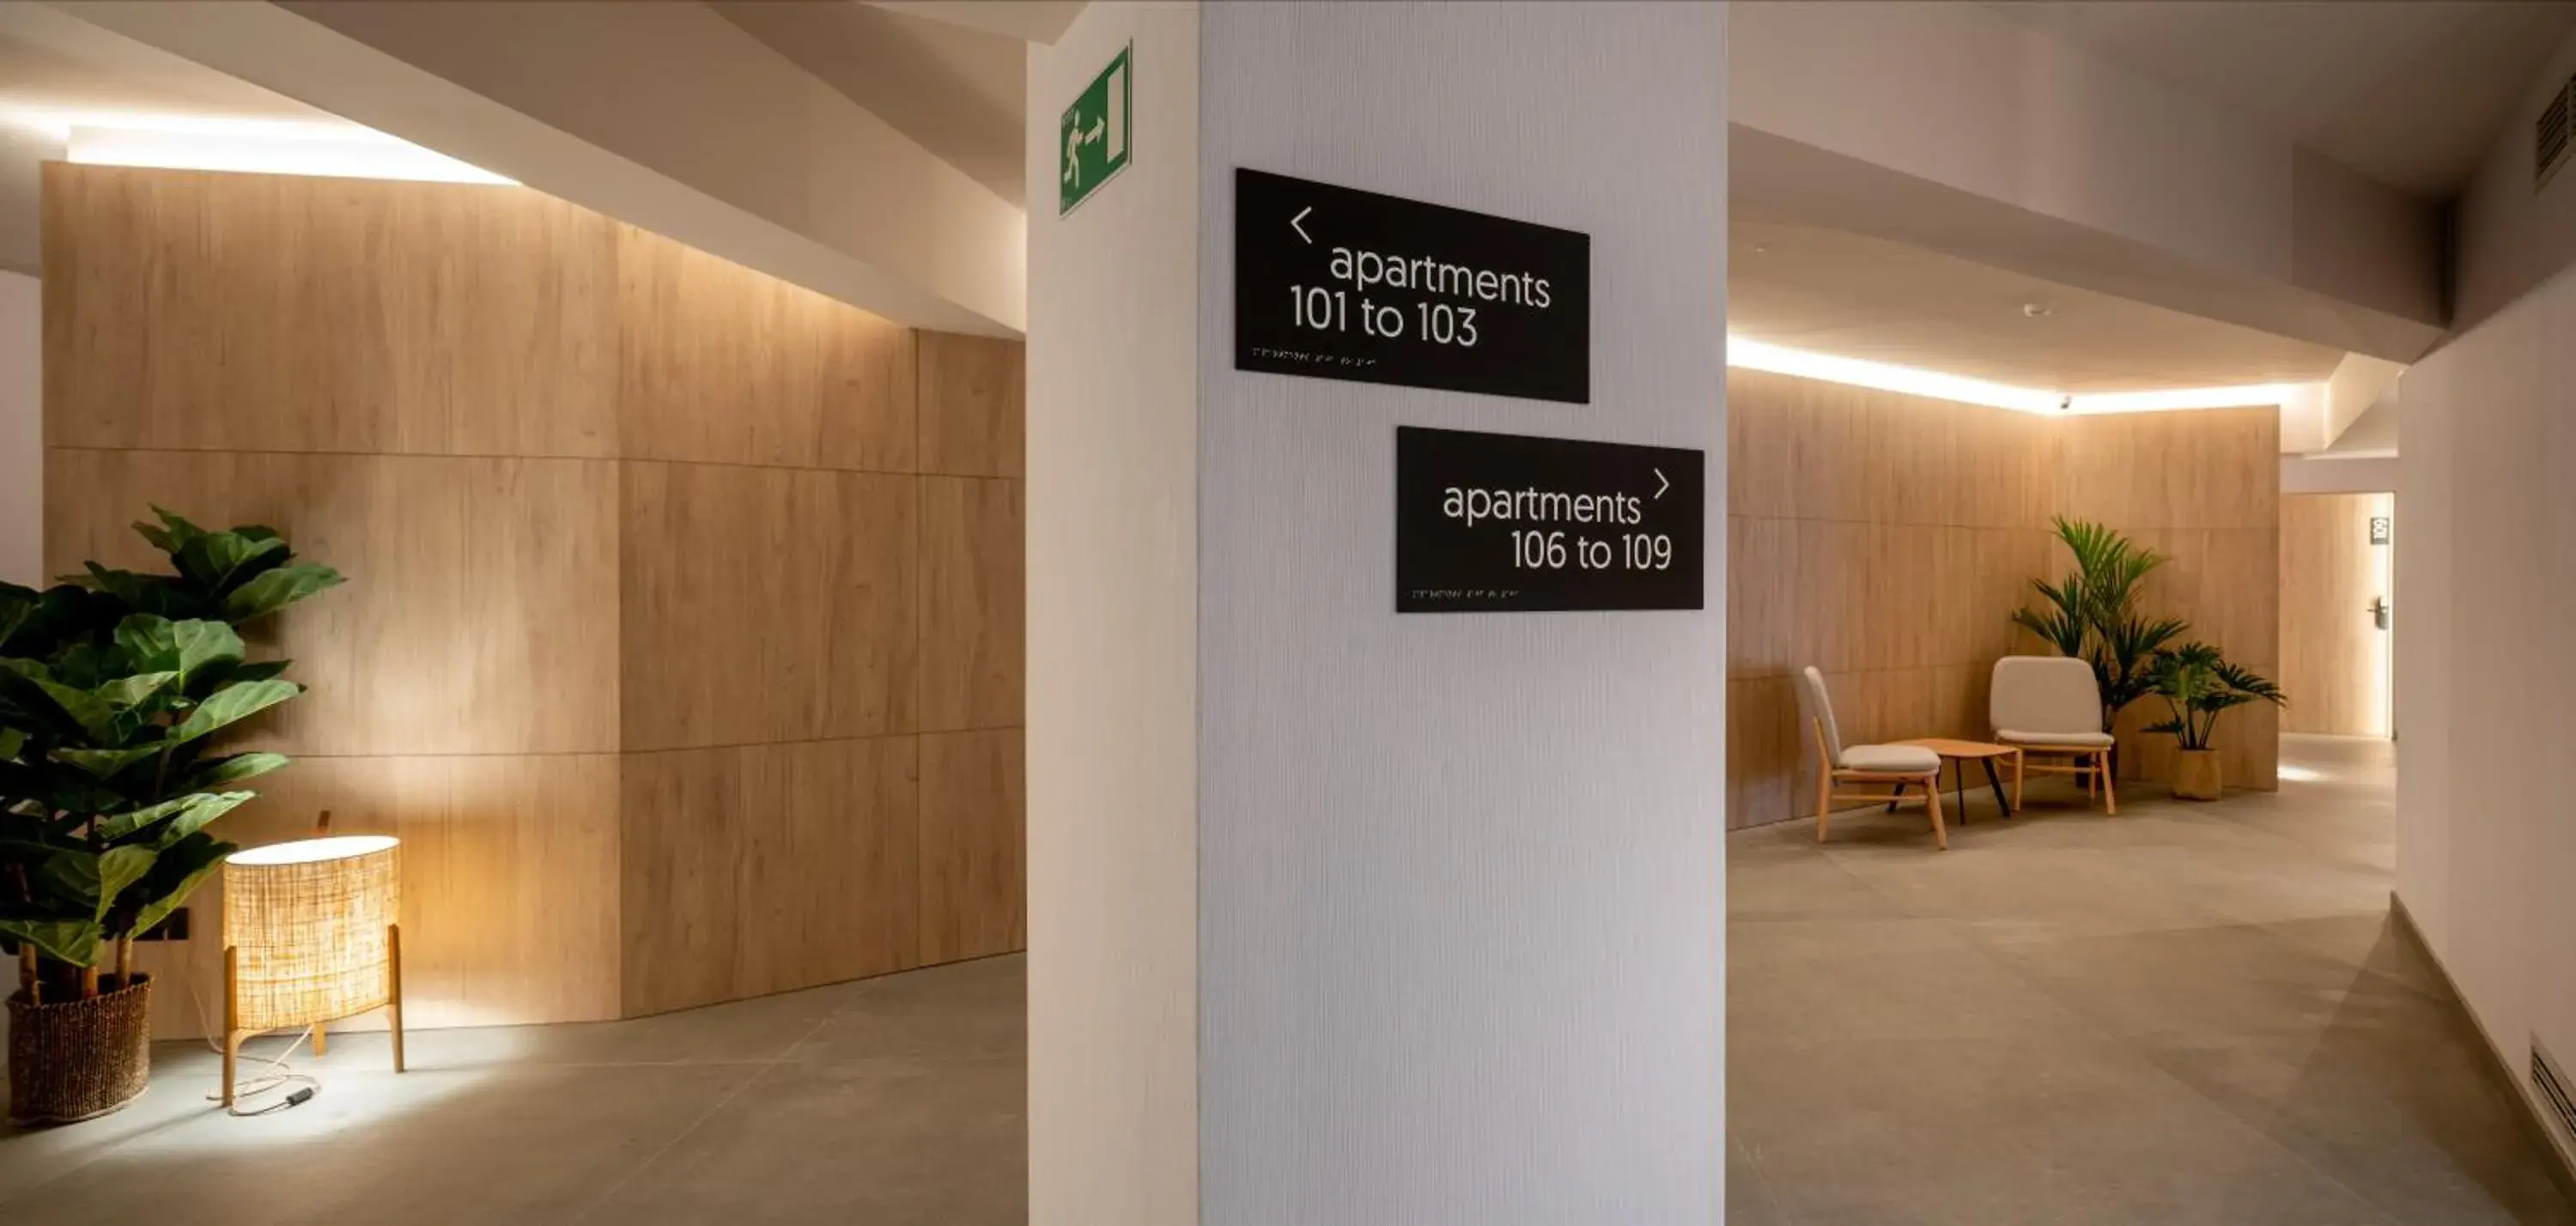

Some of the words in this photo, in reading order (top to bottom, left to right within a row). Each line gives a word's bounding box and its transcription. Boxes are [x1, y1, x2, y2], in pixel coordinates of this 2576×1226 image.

[1330, 246, 1552, 309] apartments
[1290, 284, 1346, 332] 101
[1360, 297, 1405, 338] to
[1417, 301, 1479, 348] 103
[1443, 486, 1642, 527] apartments
[1510, 529, 1567, 569] 106
[1577, 535, 1613, 570] to
[1621, 532, 1673, 570] 109
